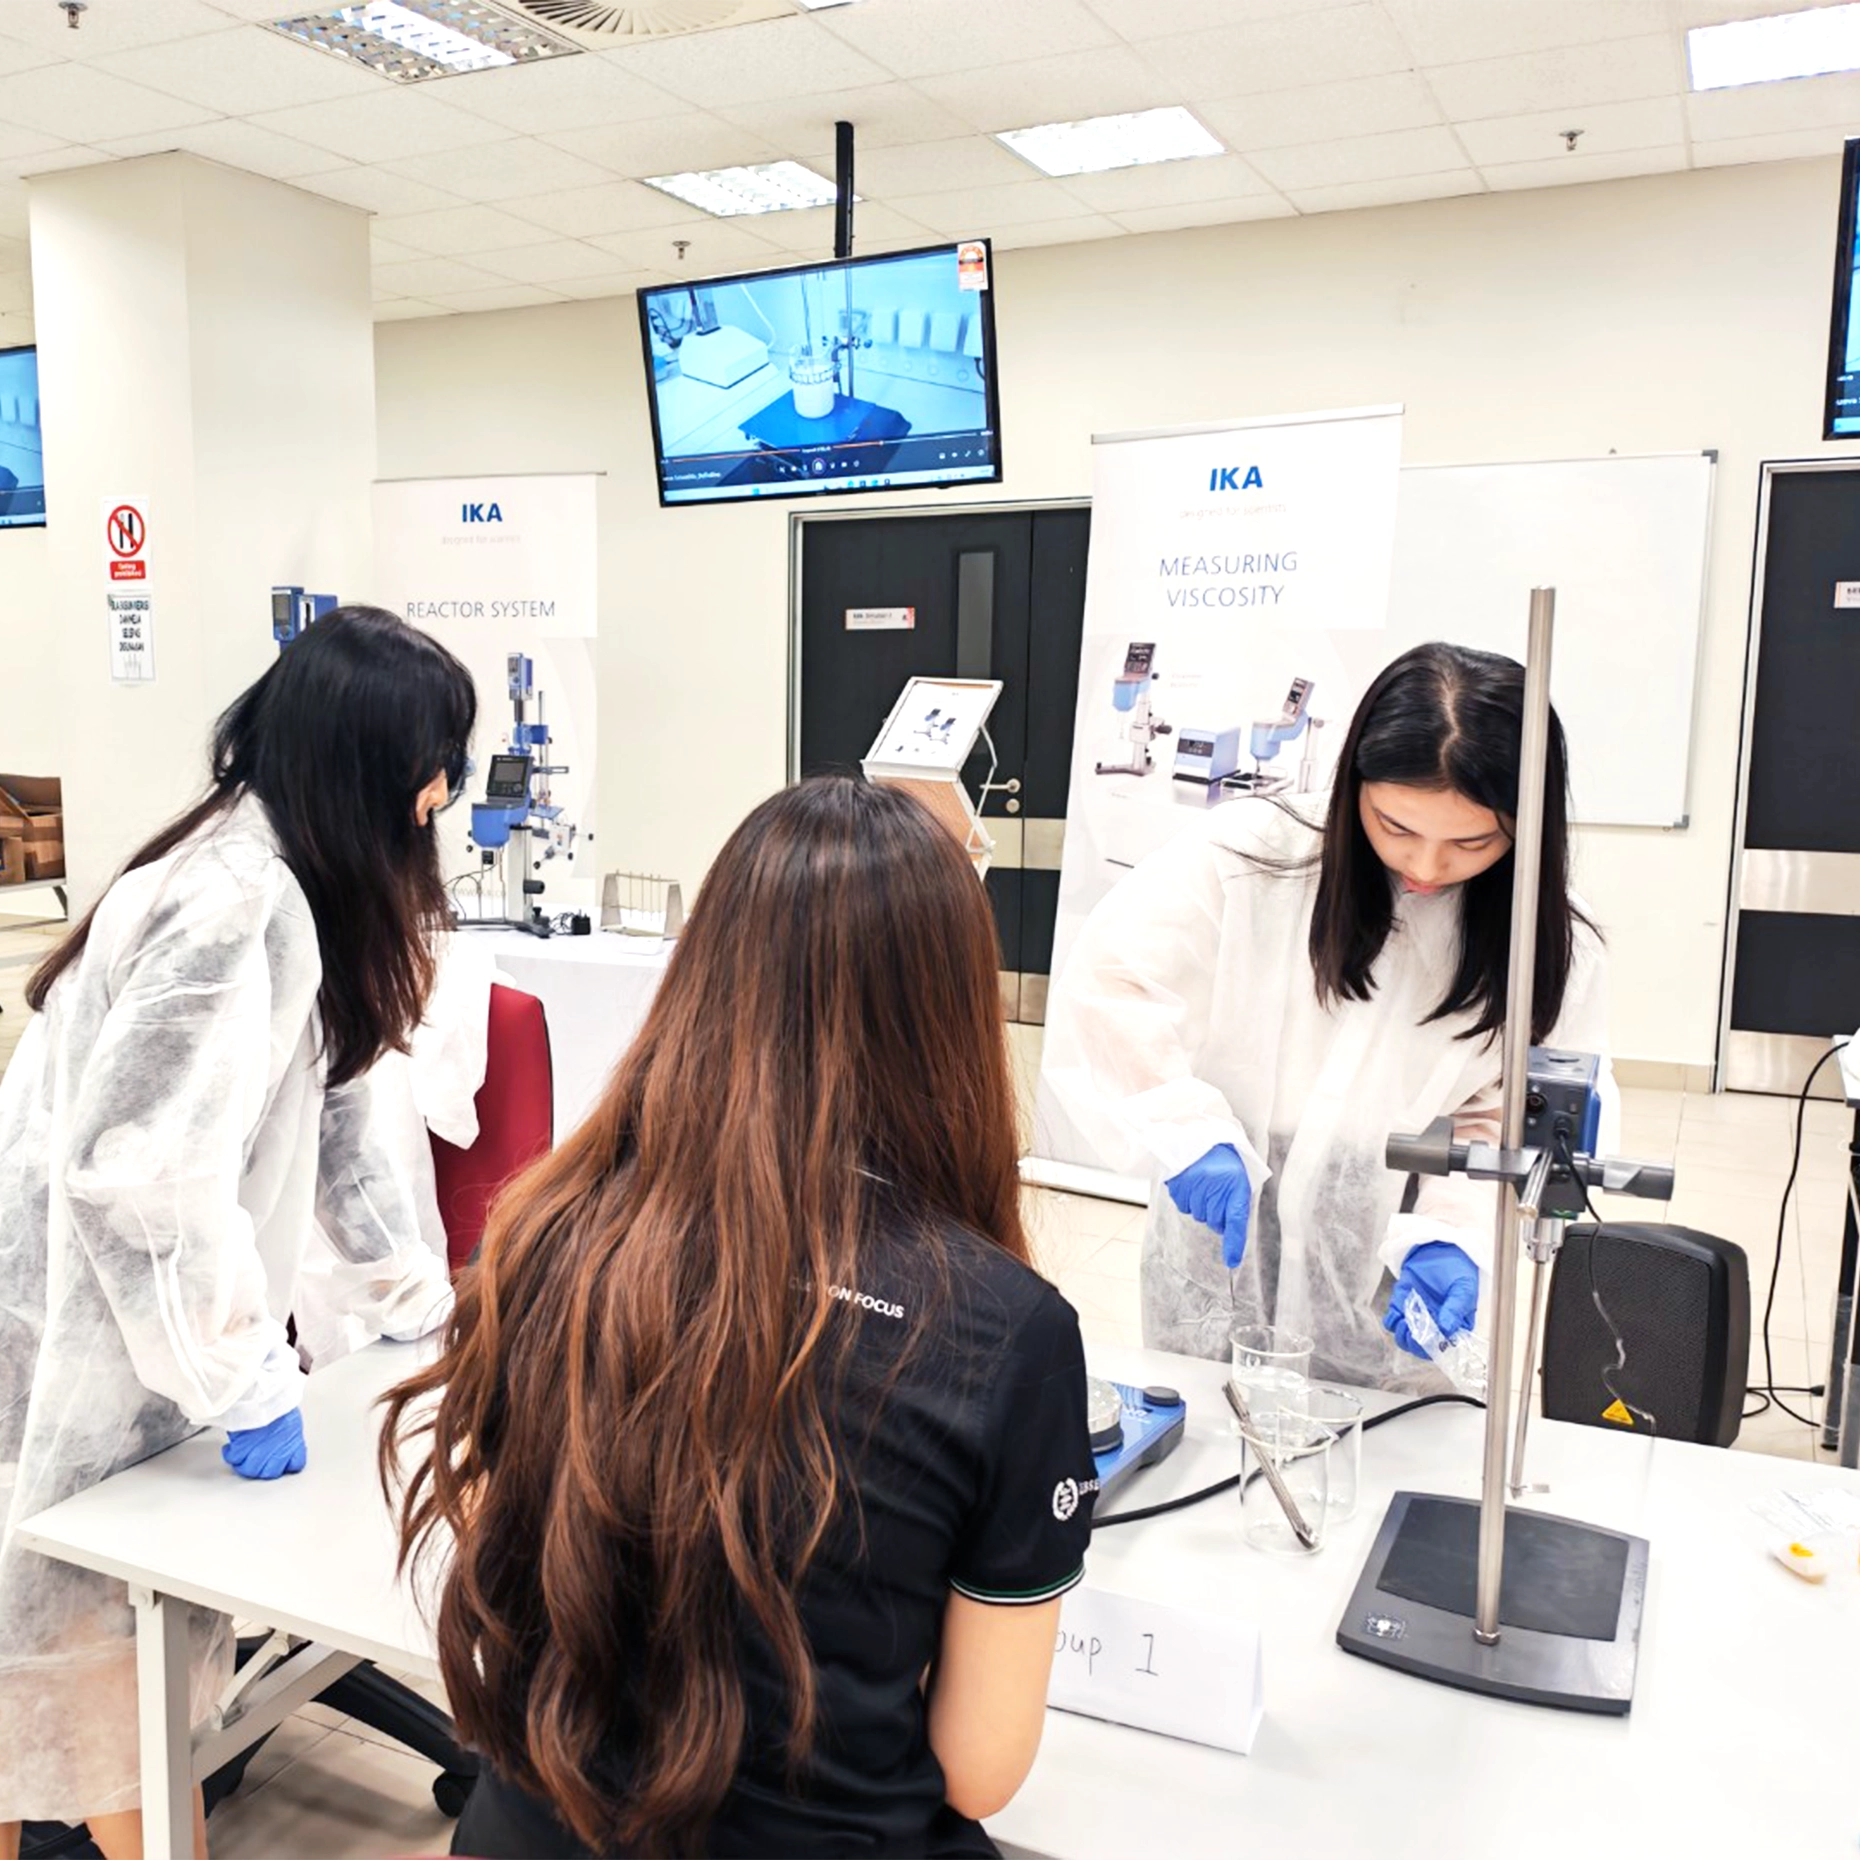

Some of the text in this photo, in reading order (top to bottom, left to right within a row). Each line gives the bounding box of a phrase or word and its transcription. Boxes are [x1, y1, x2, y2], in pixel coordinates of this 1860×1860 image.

[1209, 465, 1263, 491] IKA
[461, 502, 503, 523] IKA
[1159, 551, 1298, 577] MEASURING
[1166, 585, 1285, 607] VISCOSITY
[406, 600, 556, 619] REACTOR SYSTEM
[853, 1292, 905, 1319] FOCUS
[1134, 1633, 1160, 1677] 1
